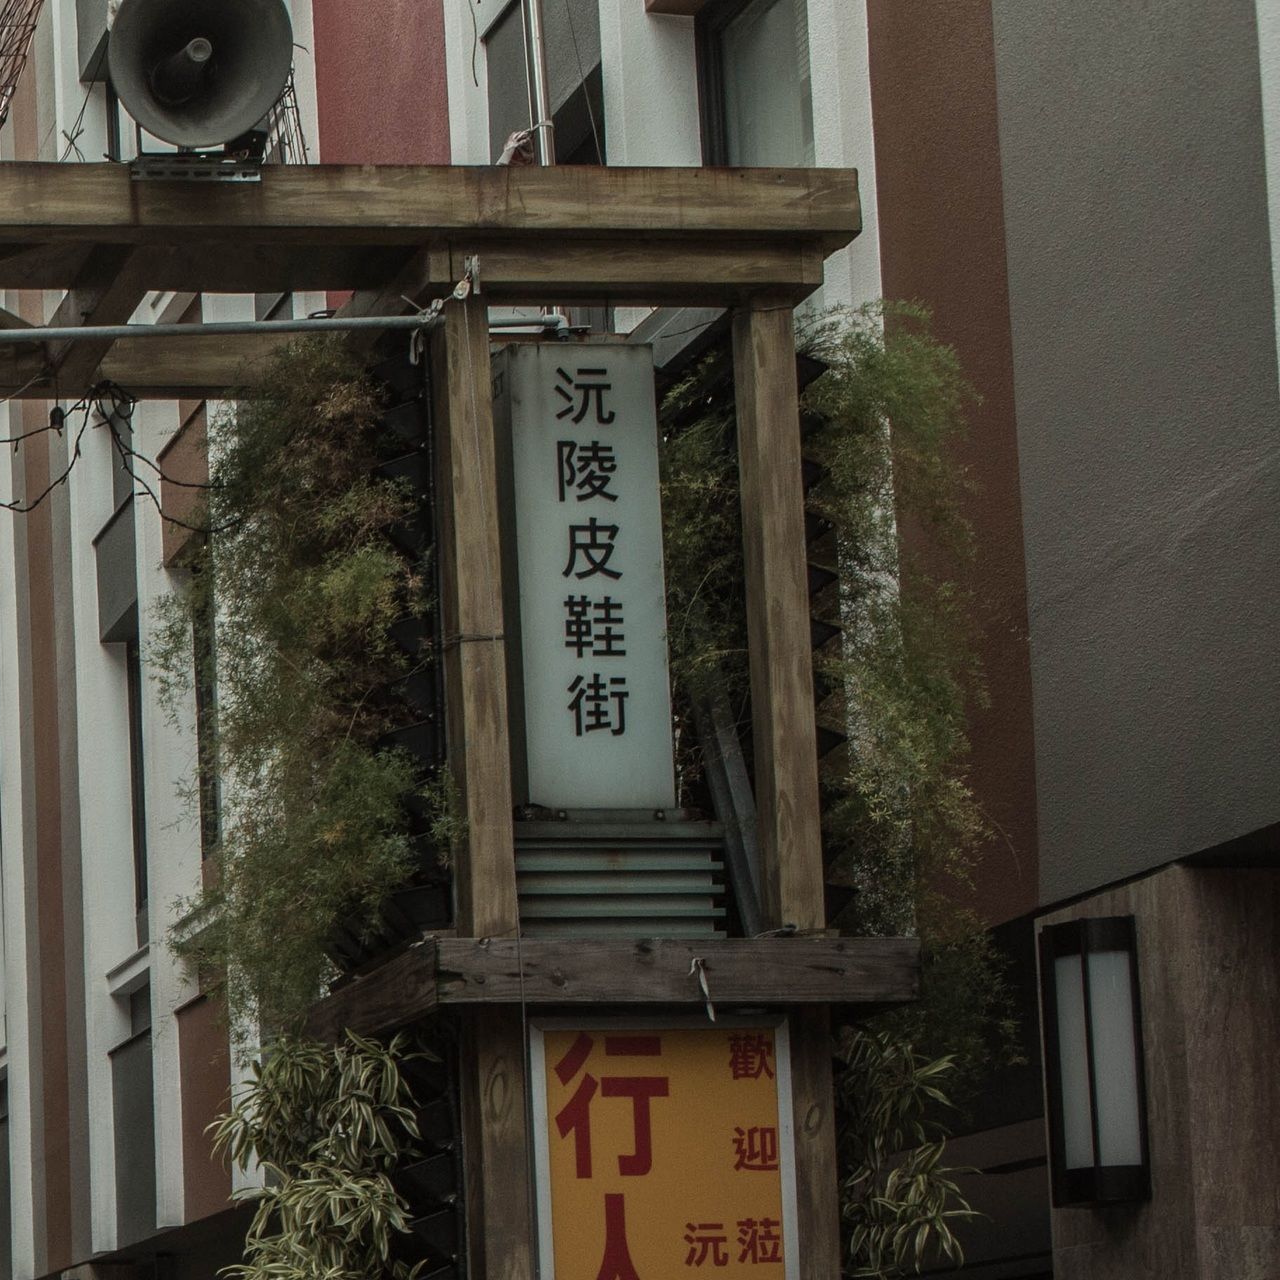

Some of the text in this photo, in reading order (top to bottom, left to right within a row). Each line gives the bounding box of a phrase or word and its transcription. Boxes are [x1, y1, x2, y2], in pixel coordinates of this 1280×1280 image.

[553, 366, 630, 737] 沅陵皮鞋街
